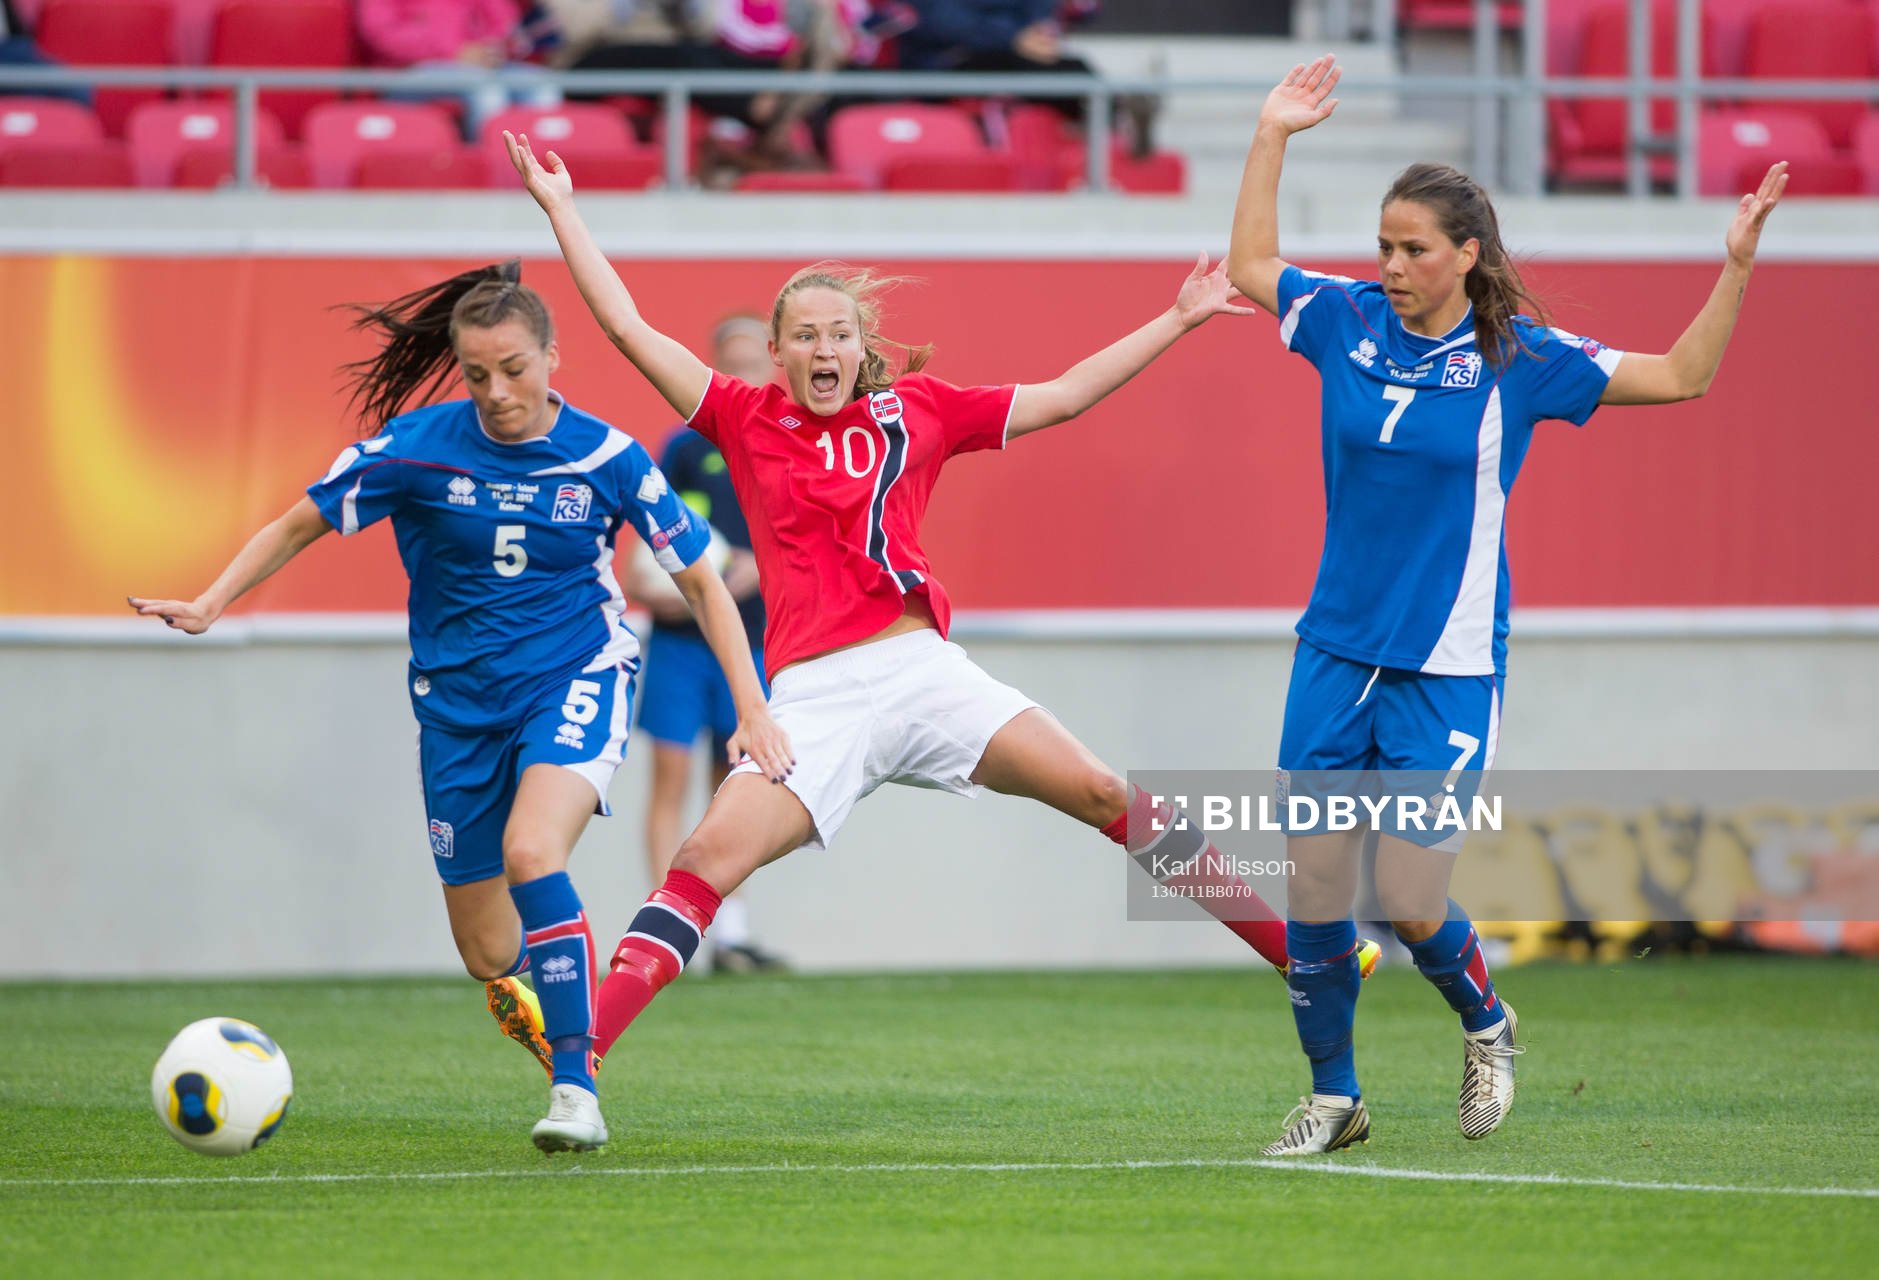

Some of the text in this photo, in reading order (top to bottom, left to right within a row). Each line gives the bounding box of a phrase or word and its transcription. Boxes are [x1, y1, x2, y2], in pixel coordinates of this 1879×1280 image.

[1379, 384, 1417, 444] 7
[815, 426, 876, 478] 10
[492, 525, 528, 577] 5
[561, 679, 601, 725] 5
[1441, 729, 1480, 790] 7
